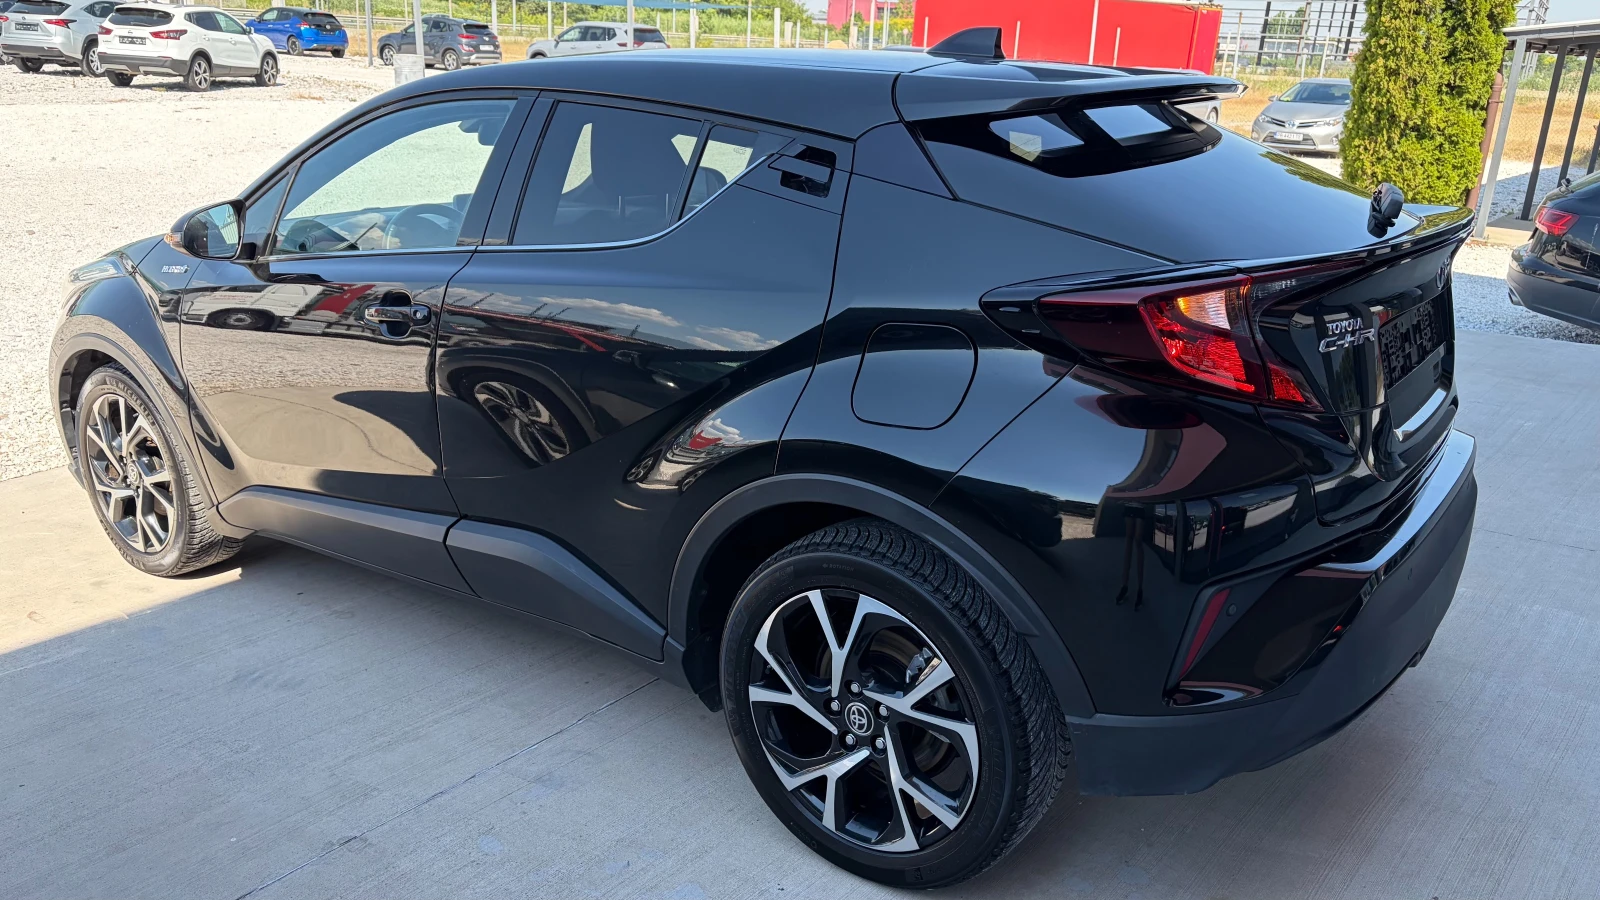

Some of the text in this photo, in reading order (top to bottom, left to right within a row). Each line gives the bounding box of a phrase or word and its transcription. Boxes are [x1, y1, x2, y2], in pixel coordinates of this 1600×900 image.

[1326, 317, 1363, 334] TOYOTA
[1319, 328, 1375, 352] C-HR
[117, 381, 155, 425] MICHELIN
